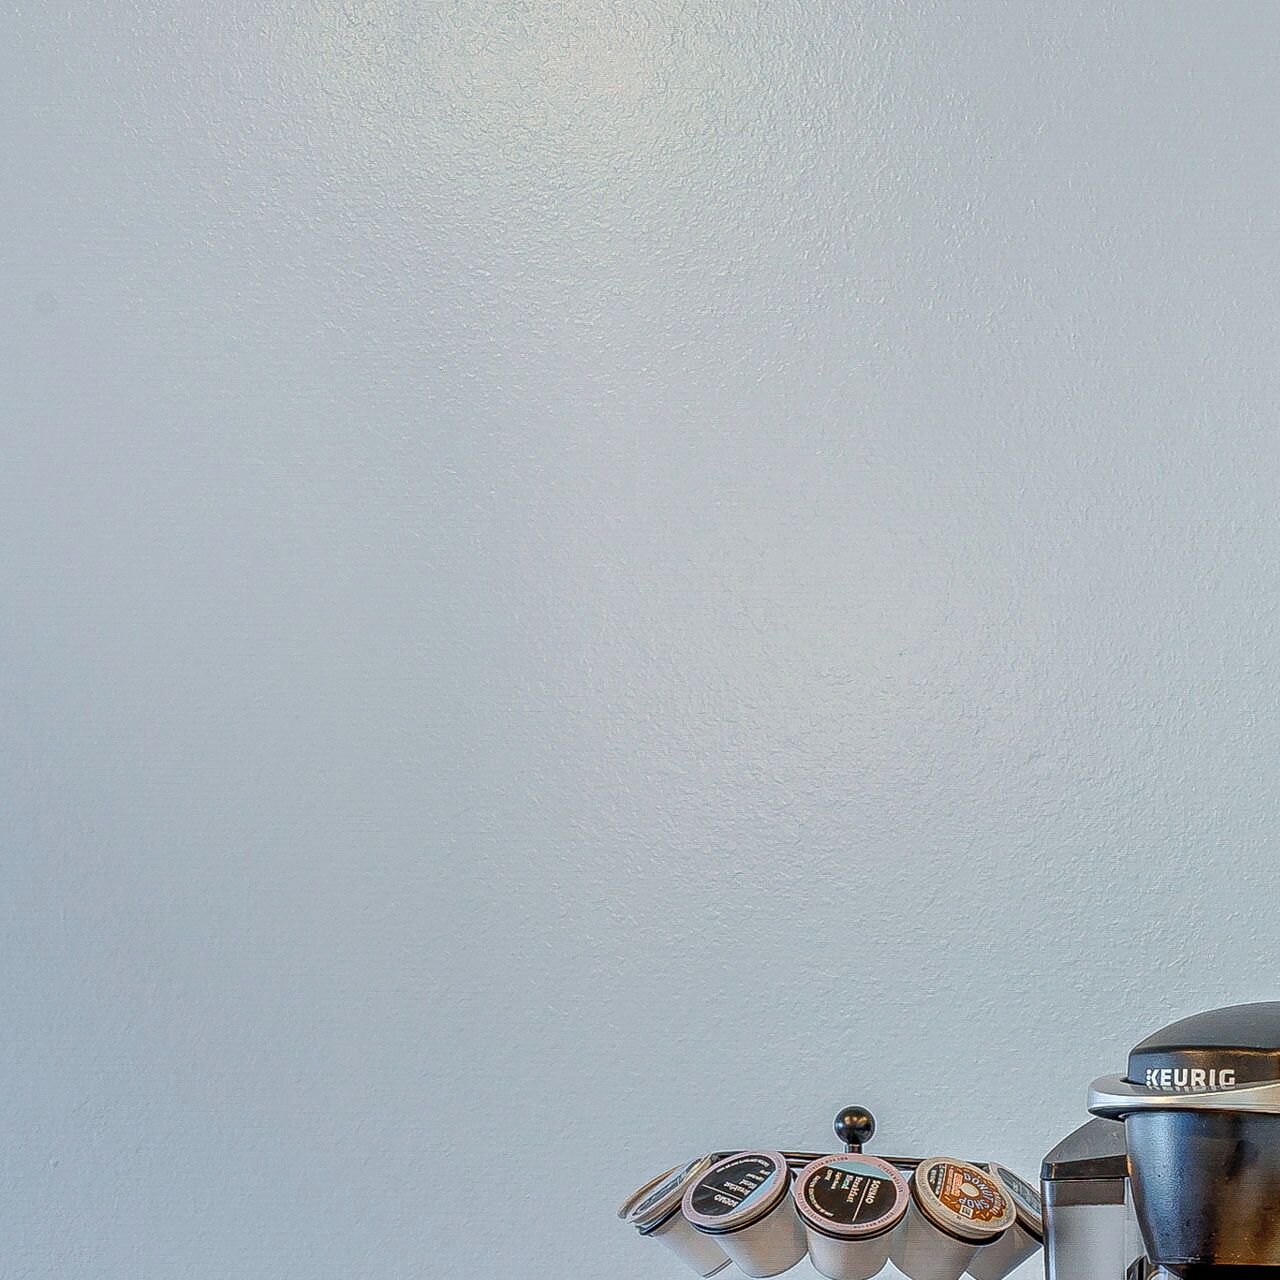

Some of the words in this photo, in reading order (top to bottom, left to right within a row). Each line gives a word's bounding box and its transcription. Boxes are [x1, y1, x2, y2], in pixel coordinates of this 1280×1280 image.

[1145, 1068, 1236, 1087] KEURIG
[963, 1172, 994, 1204] DONUT
[959, 1197, 990, 1211] SHOP
